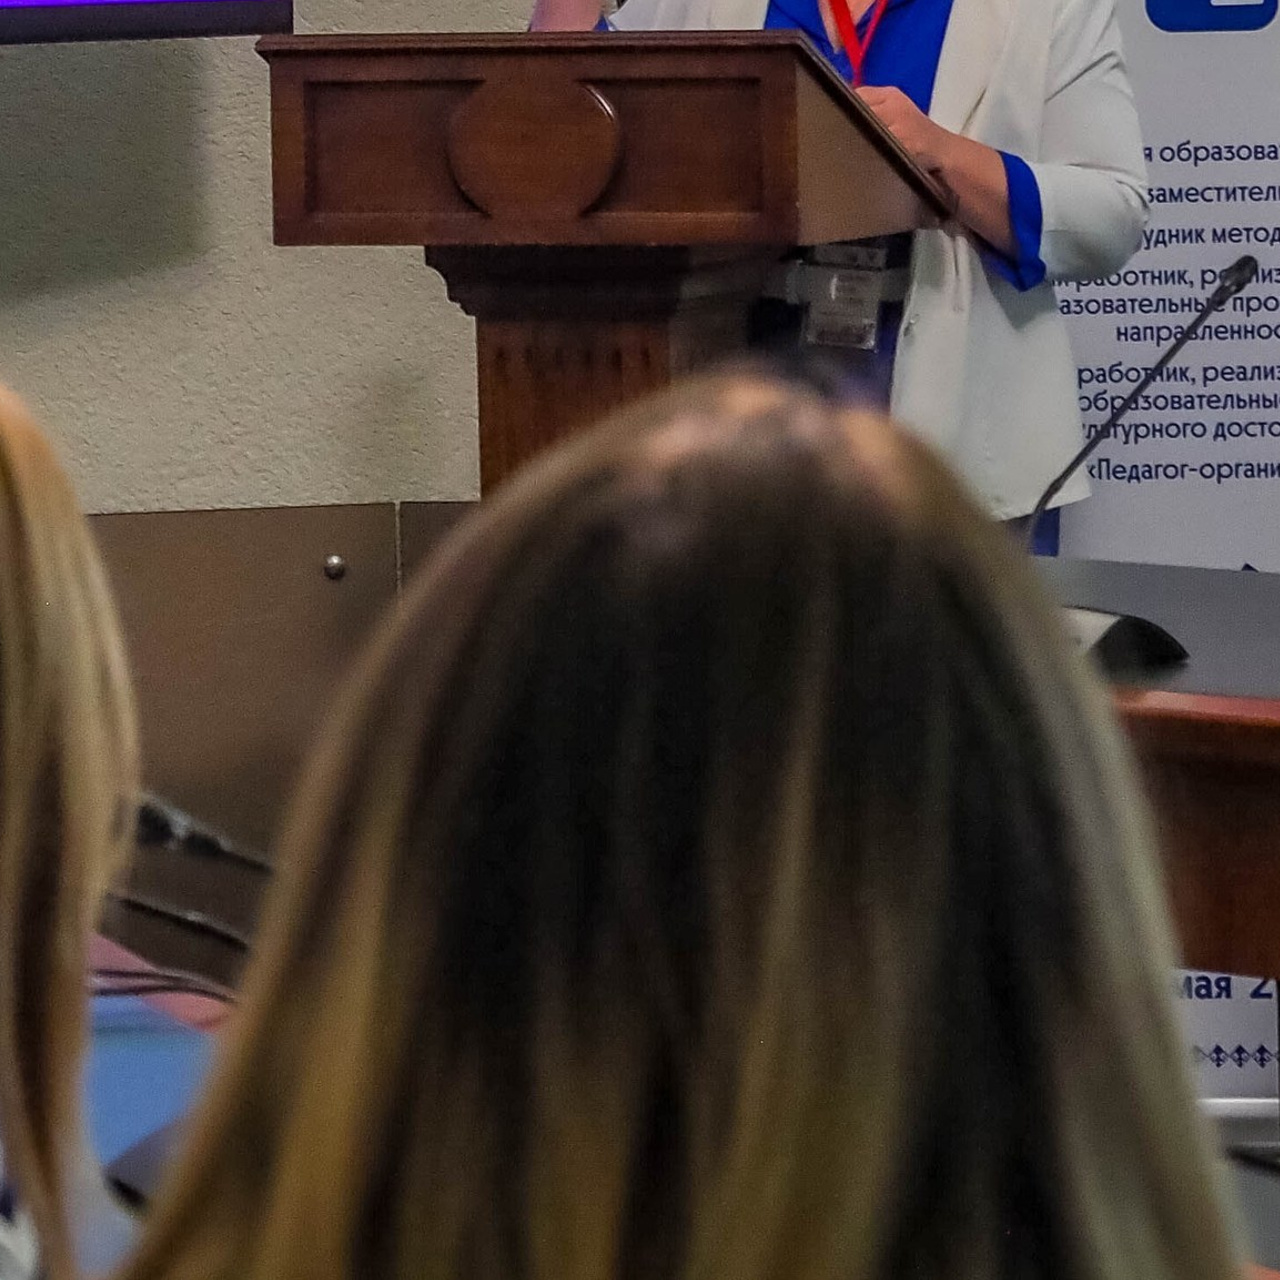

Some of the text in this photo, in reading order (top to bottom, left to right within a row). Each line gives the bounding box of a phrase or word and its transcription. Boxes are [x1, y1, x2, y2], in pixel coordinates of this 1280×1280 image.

[1160, 140, 1280, 167] образова
[1147, 186, 1280, 204] заместител
[1079, 389, 1280, 417] образовательны
